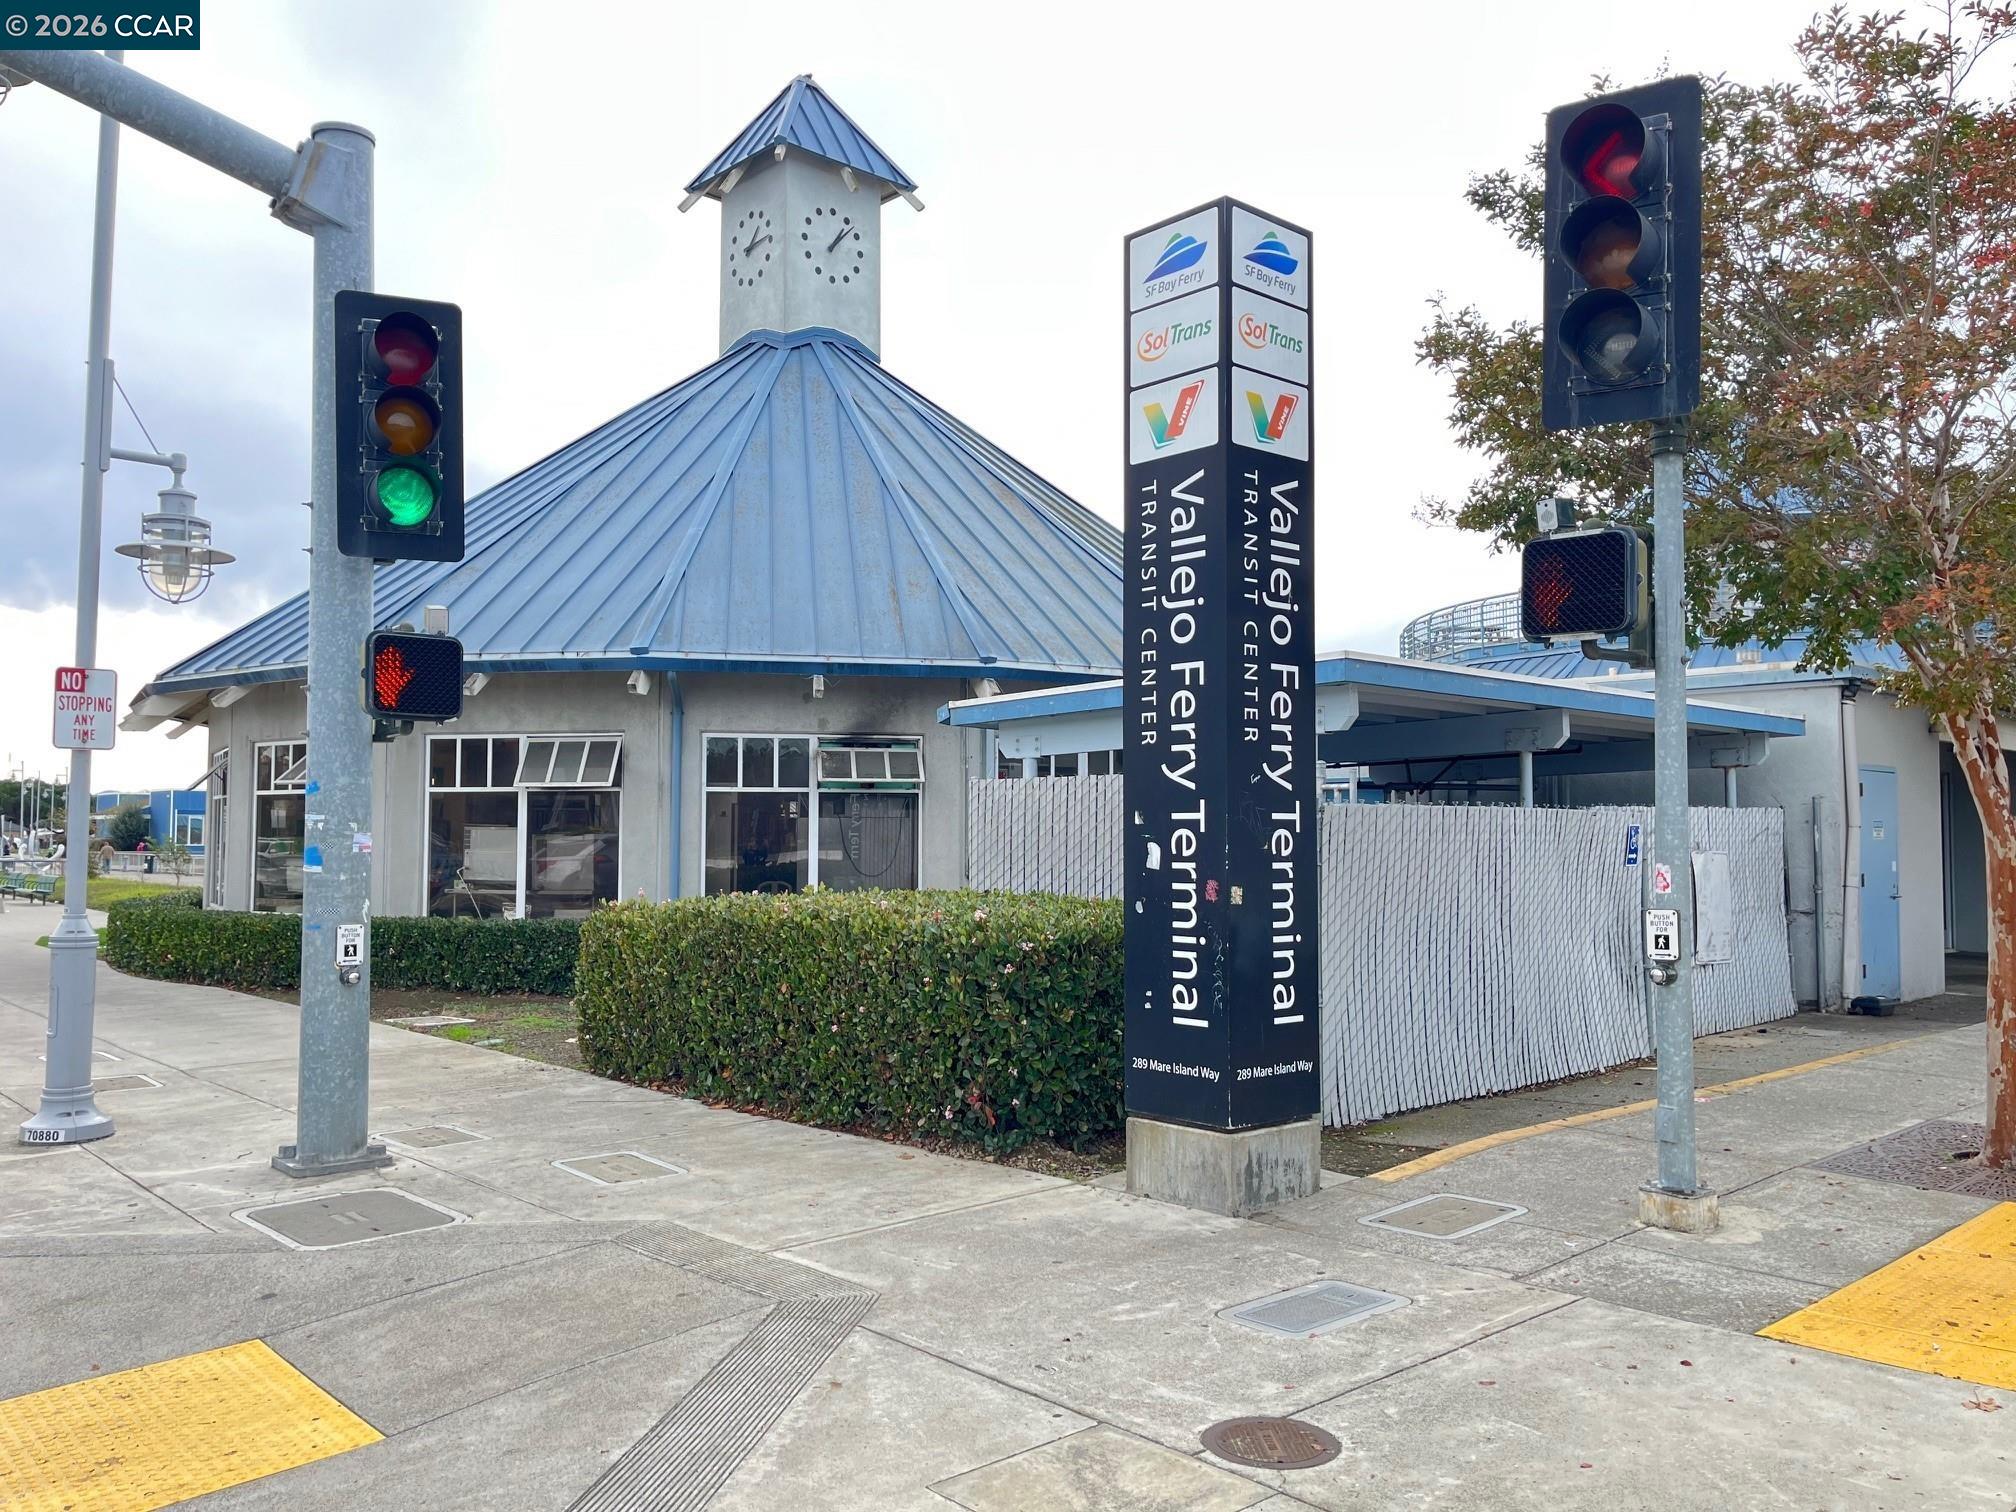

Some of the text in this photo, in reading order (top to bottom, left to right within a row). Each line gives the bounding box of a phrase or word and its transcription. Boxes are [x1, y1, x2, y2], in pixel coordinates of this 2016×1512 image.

[1145, 269, 1205, 298] SF Bay Ferry
[1244, 265, 1296, 295] SF Bay Ferry
[1178, 397, 1192, 427] VINE
[1277, 406, 1290, 431] VINE
[1141, 480, 1157, 745] TRANSIT CENTER
[1243, 470, 1259, 741] TRANSIT CENTER
[61, 671, 82, 690] NO
[58, 694, 112, 712] STOPPING
[73, 714, 95, 726] ANY
[73, 728, 96, 741] TIME
[1161, 468, 1209, 1028] Vallejo Ferry Terminal
[1262, 480, 1304, 1025] Vallejo Ferry Terminal
[1132, 1057, 1220, 1083] 289 Mare Island Way
[1236, 1059, 1313, 1081] 289 Mare Island Way
[27, 1130, 60, 1141] 70880
